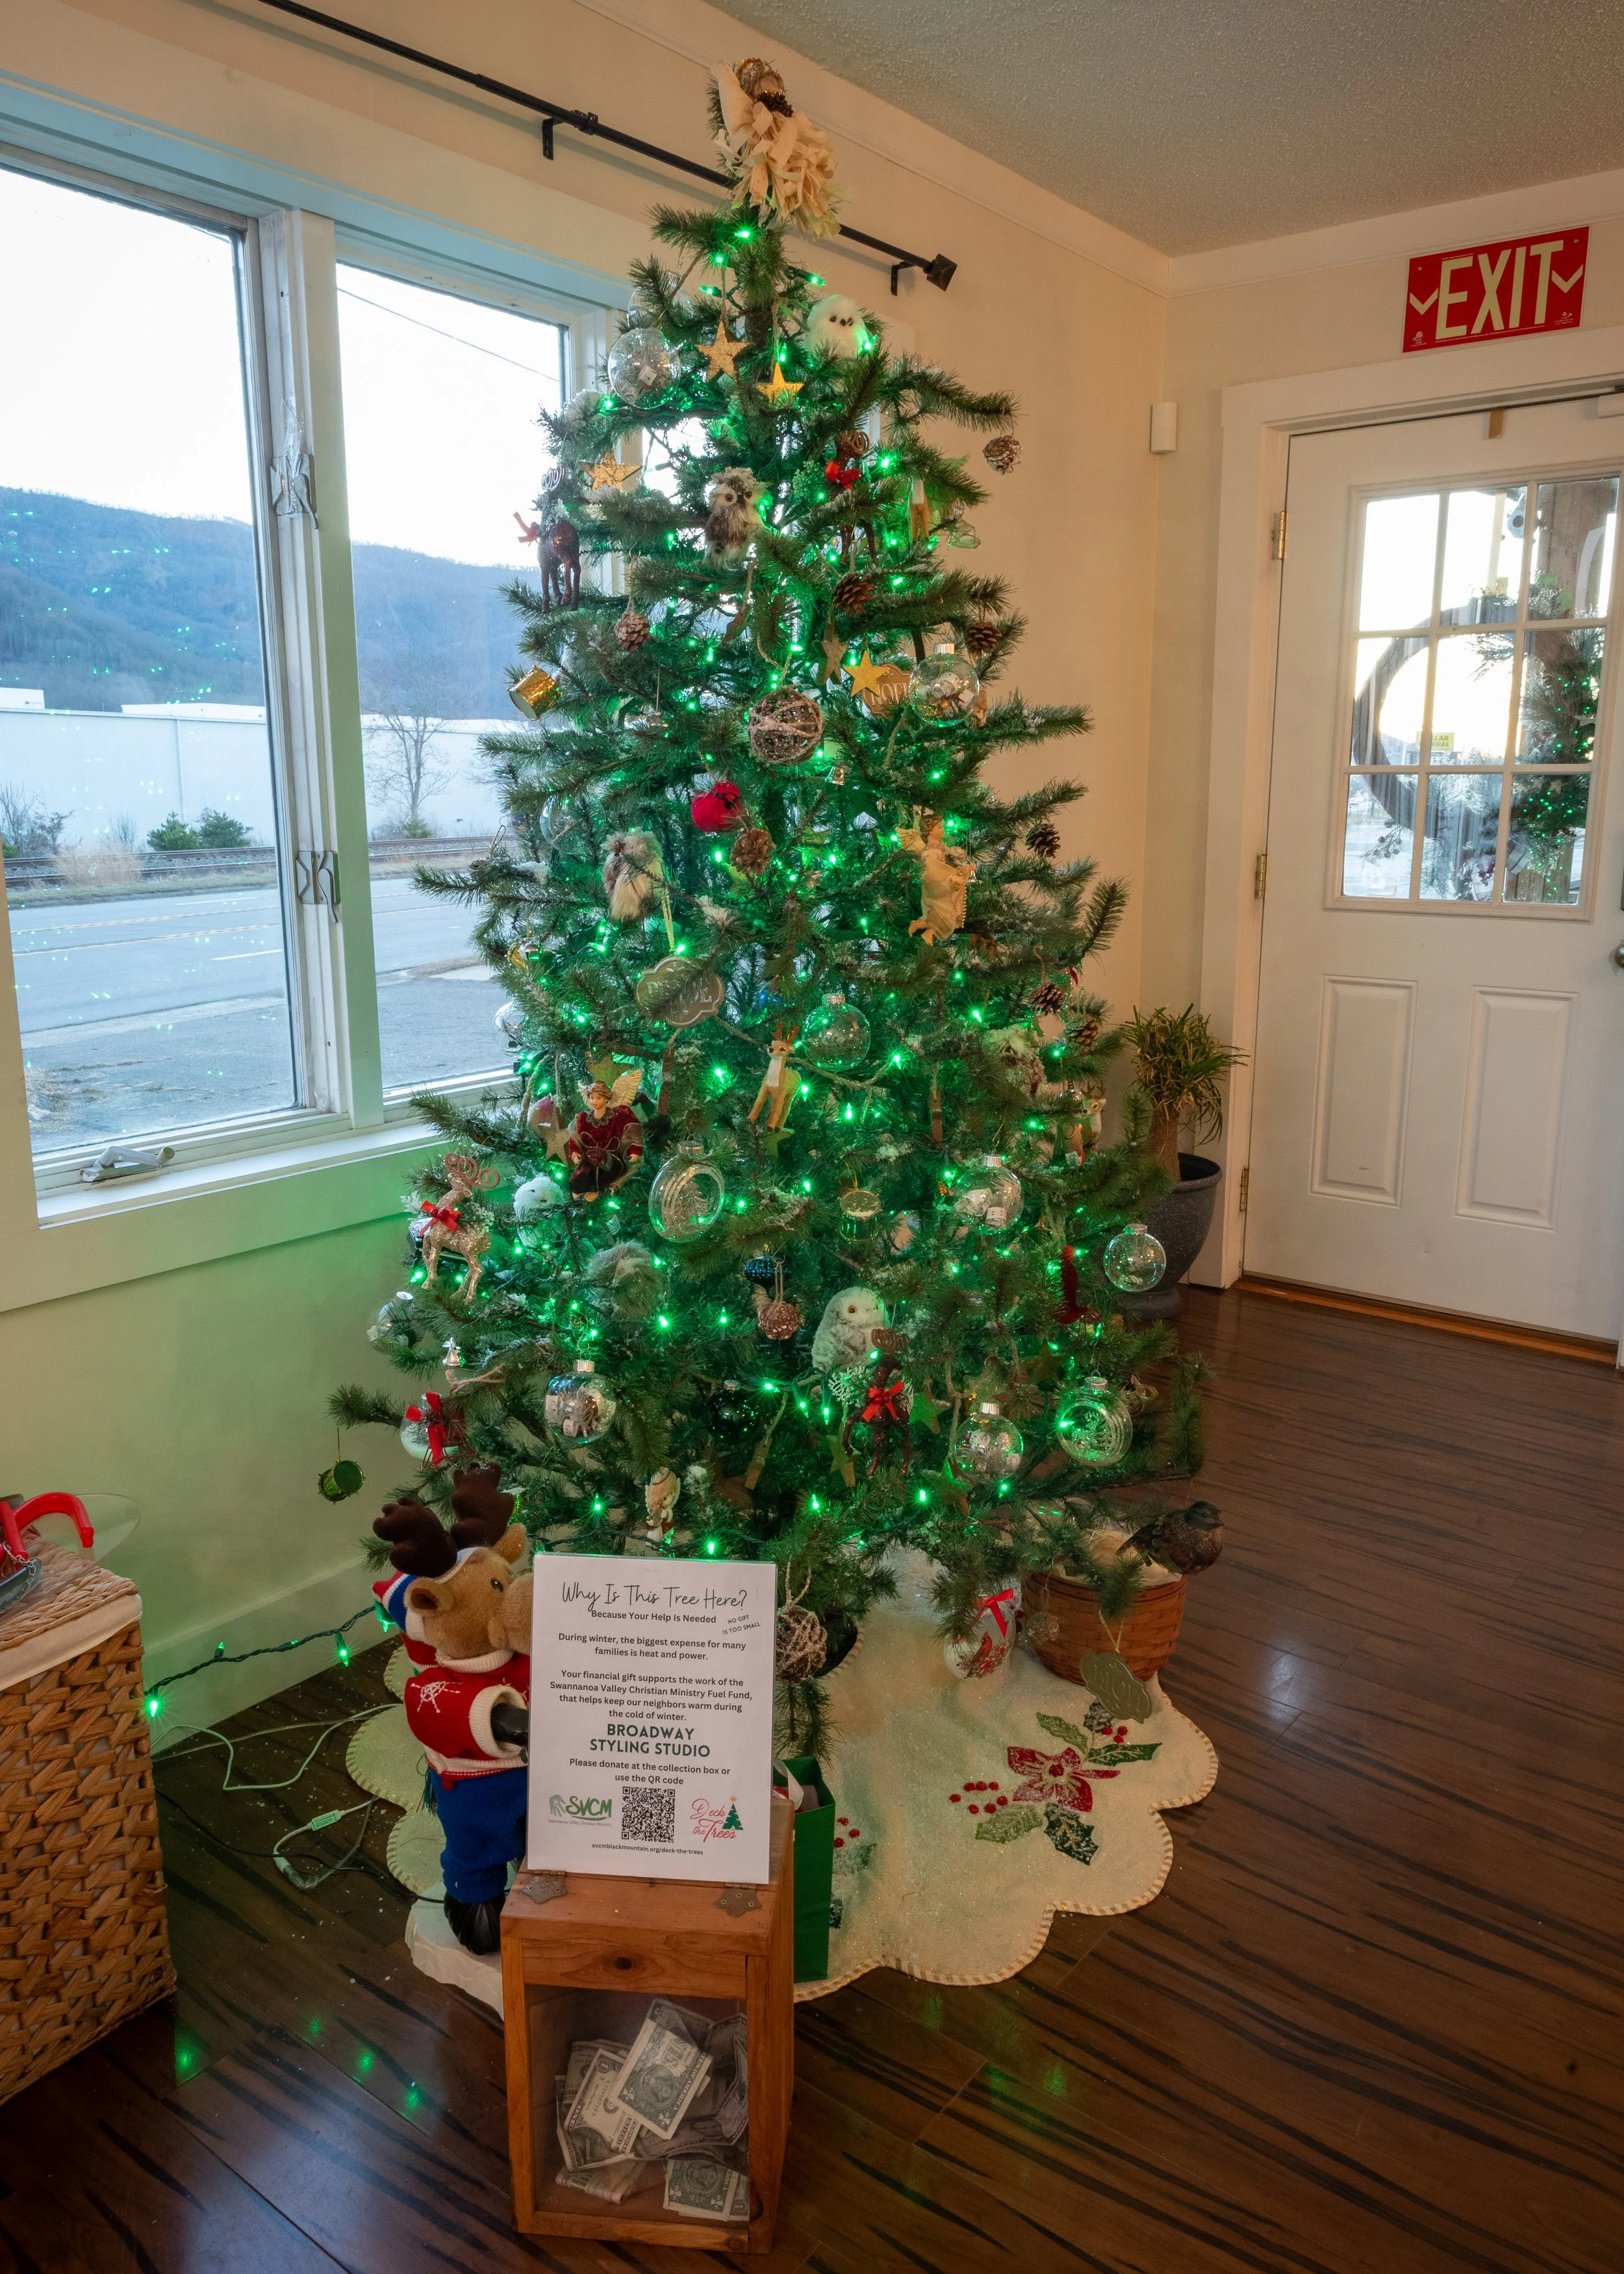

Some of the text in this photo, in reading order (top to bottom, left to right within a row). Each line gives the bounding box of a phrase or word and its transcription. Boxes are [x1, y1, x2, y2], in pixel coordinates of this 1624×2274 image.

[1435, 240, 1564, 340] EXIT
[563, 1581, 747, 1611] Why Is This Tree Here?
[591, 1610, 627, 1619] Because
[651, 1613, 671, 1623] Help
[683, 1615, 717, 1623] Needed
[743, 1622, 761, 1630] SMALL
[559, 1633, 746, 1651] During winter, the biggest expense for many
[595, 1646, 628, 1656] families
[631, 1648, 637, 1657] is
[639, 1649, 659, 1657] heat
[561, 1670, 581, 1678] Your
[583, 1670, 620, 1680] financial
[621, 1673, 637, 1683] gift
[638, 1676, 677, 1684] supports
[678, 1676, 693, 1684] the
[729, 1678, 744, 1687] the
[550, 1681, 599, 1691] Swannanoa
[600, 1684, 627, 1694] Valley
[629, 1686, 668, 1695] Christian
[670, 1688, 705, 1698] Ministry
[728, 1691, 752, 1701] Fund,
[559, 1694, 577, 1702] that
[579, 1695, 602, 1706] helps
[604, 1696, 624, 1707] keep
[643, 1699, 686, 1709] neighbors
[714, 1702, 742, 1713] during
[657, 1712, 687, 1720] winter.
[607, 1724, 694, 1740] BROADWAY
[590, 1739, 710, 1757] STYLING STUDIO
[570, 1758, 597, 1767] Please
[599, 1760, 629, 1769] donate
[642, 1762, 656, 1770] the
[658, 1764, 701, 1773] collection
[704, 1766, 719, 1774] box
[648, 1775, 661, 1784] QR
[663, 1776, 684, 1785] code
[565, 1795, 613, 1818] SVCM
[690, 1798, 726, 1819] Deck
[692, 1819, 737, 1843] the Trees
[592, 1843, 703, 1855] svcmblackmountain.org/deck-the-trees
